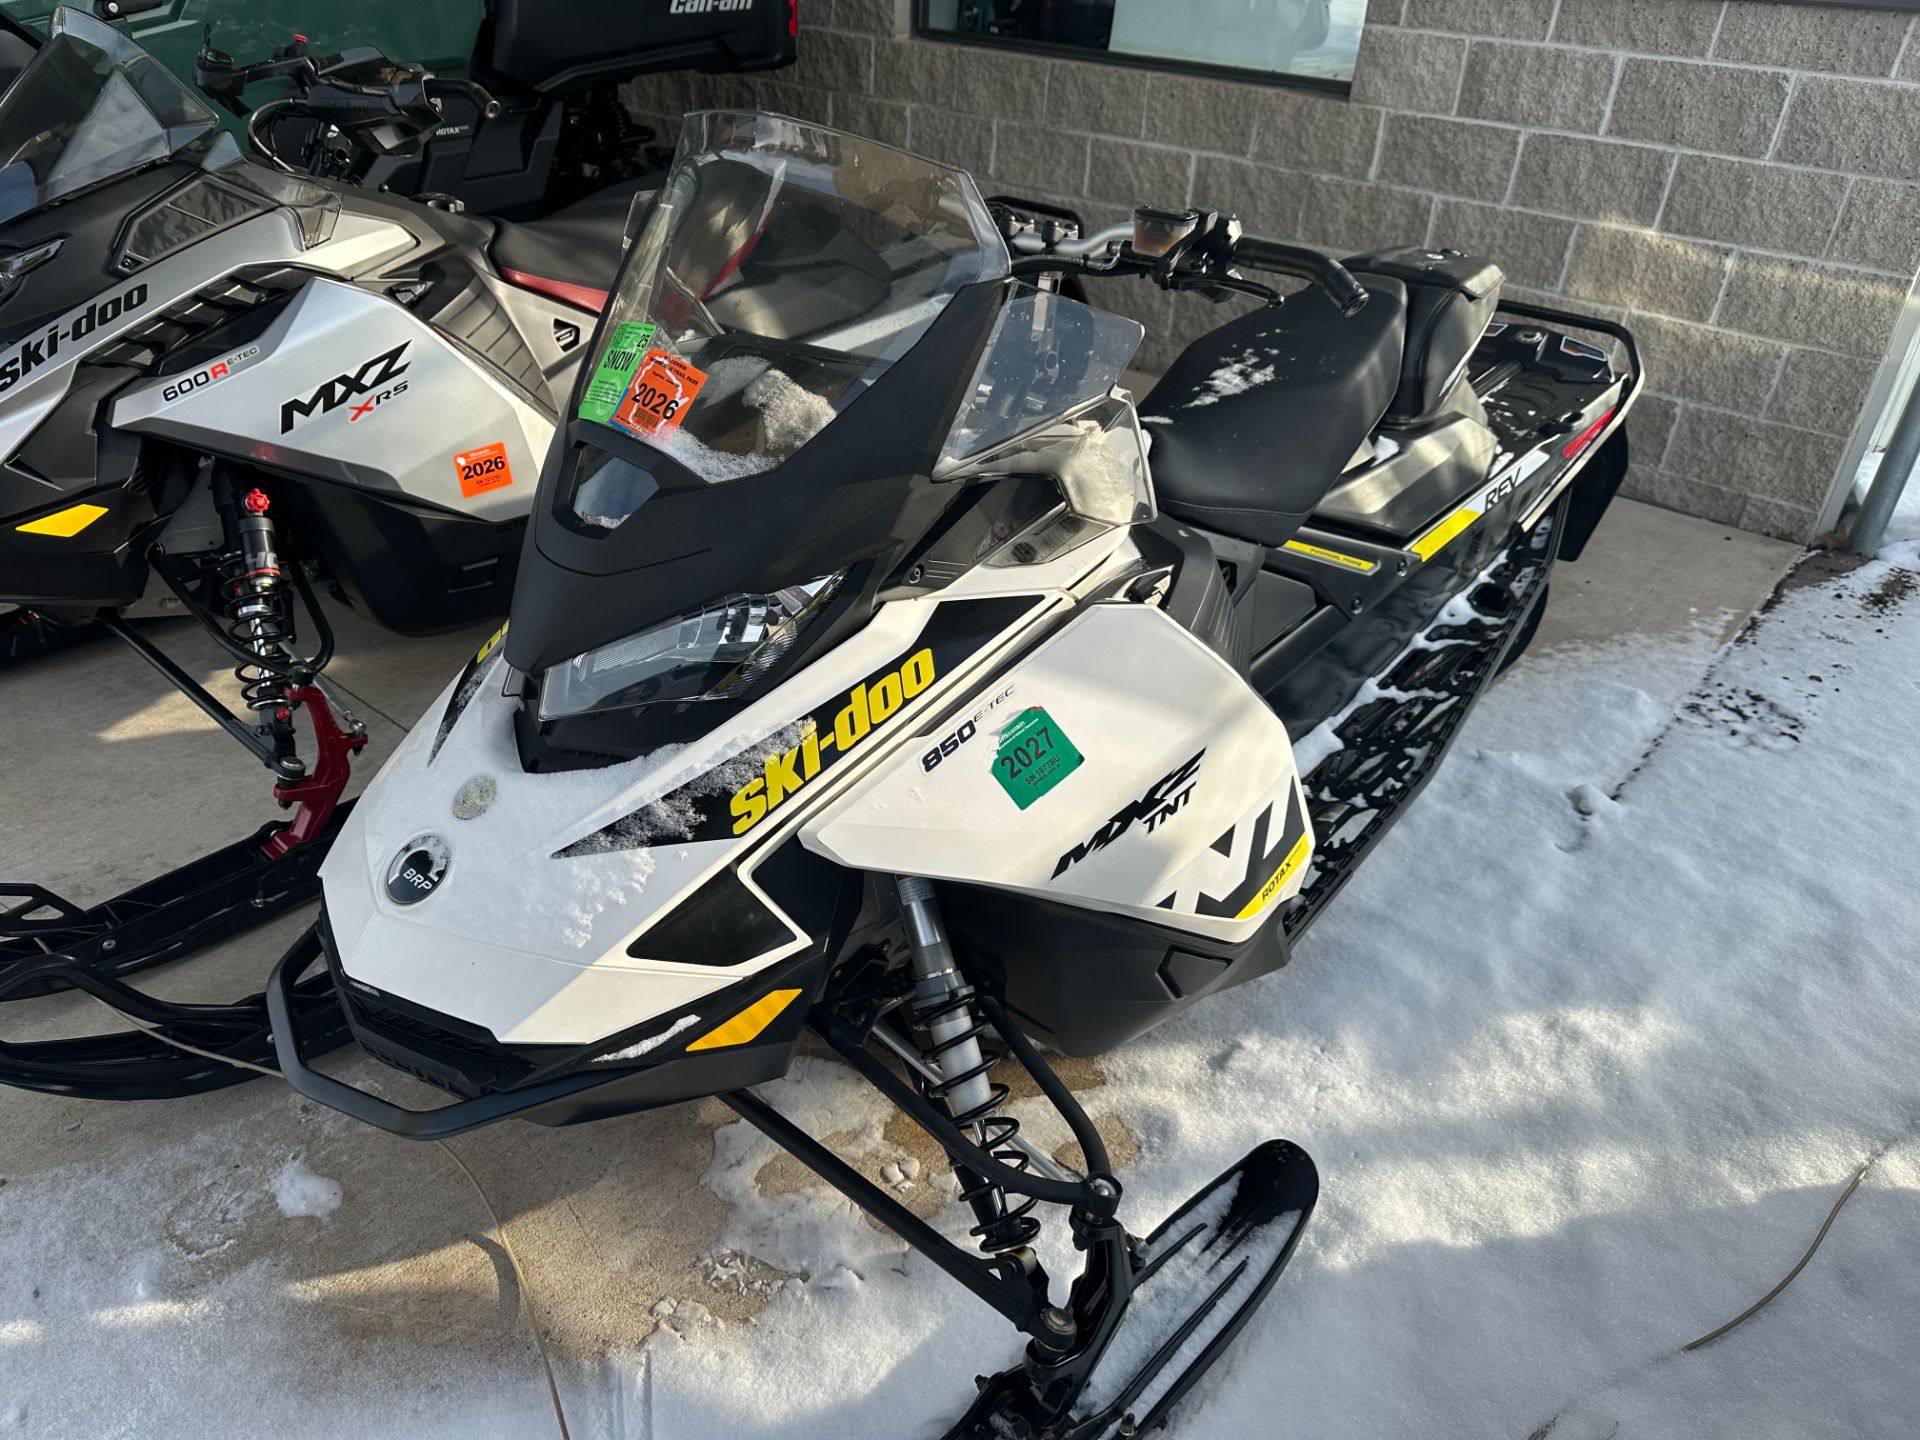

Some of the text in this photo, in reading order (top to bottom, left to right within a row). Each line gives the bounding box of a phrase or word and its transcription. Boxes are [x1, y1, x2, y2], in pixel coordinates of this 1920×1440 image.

[603, 350, 637, 372] SNOW
[637, 333, 651, 349] 25
[162, 346, 258, 402] 600R E-TEC
[280, 338, 412, 435] MXZ
[631, 383, 679, 420] 2026
[461, 455, 506, 481] 2026
[922, 719, 977, 773] 850
[973, 684, 1015, 722] E-TEC
[1000, 726, 1054, 780] 2027
[1024, 773, 1037, 785] SN
[1050, 746, 1207, 881] MXZ
[1142, 780, 1197, 834] TNT
[402, 867, 433, 890] BRP
[1262, 862, 1291, 902] ROTAX
